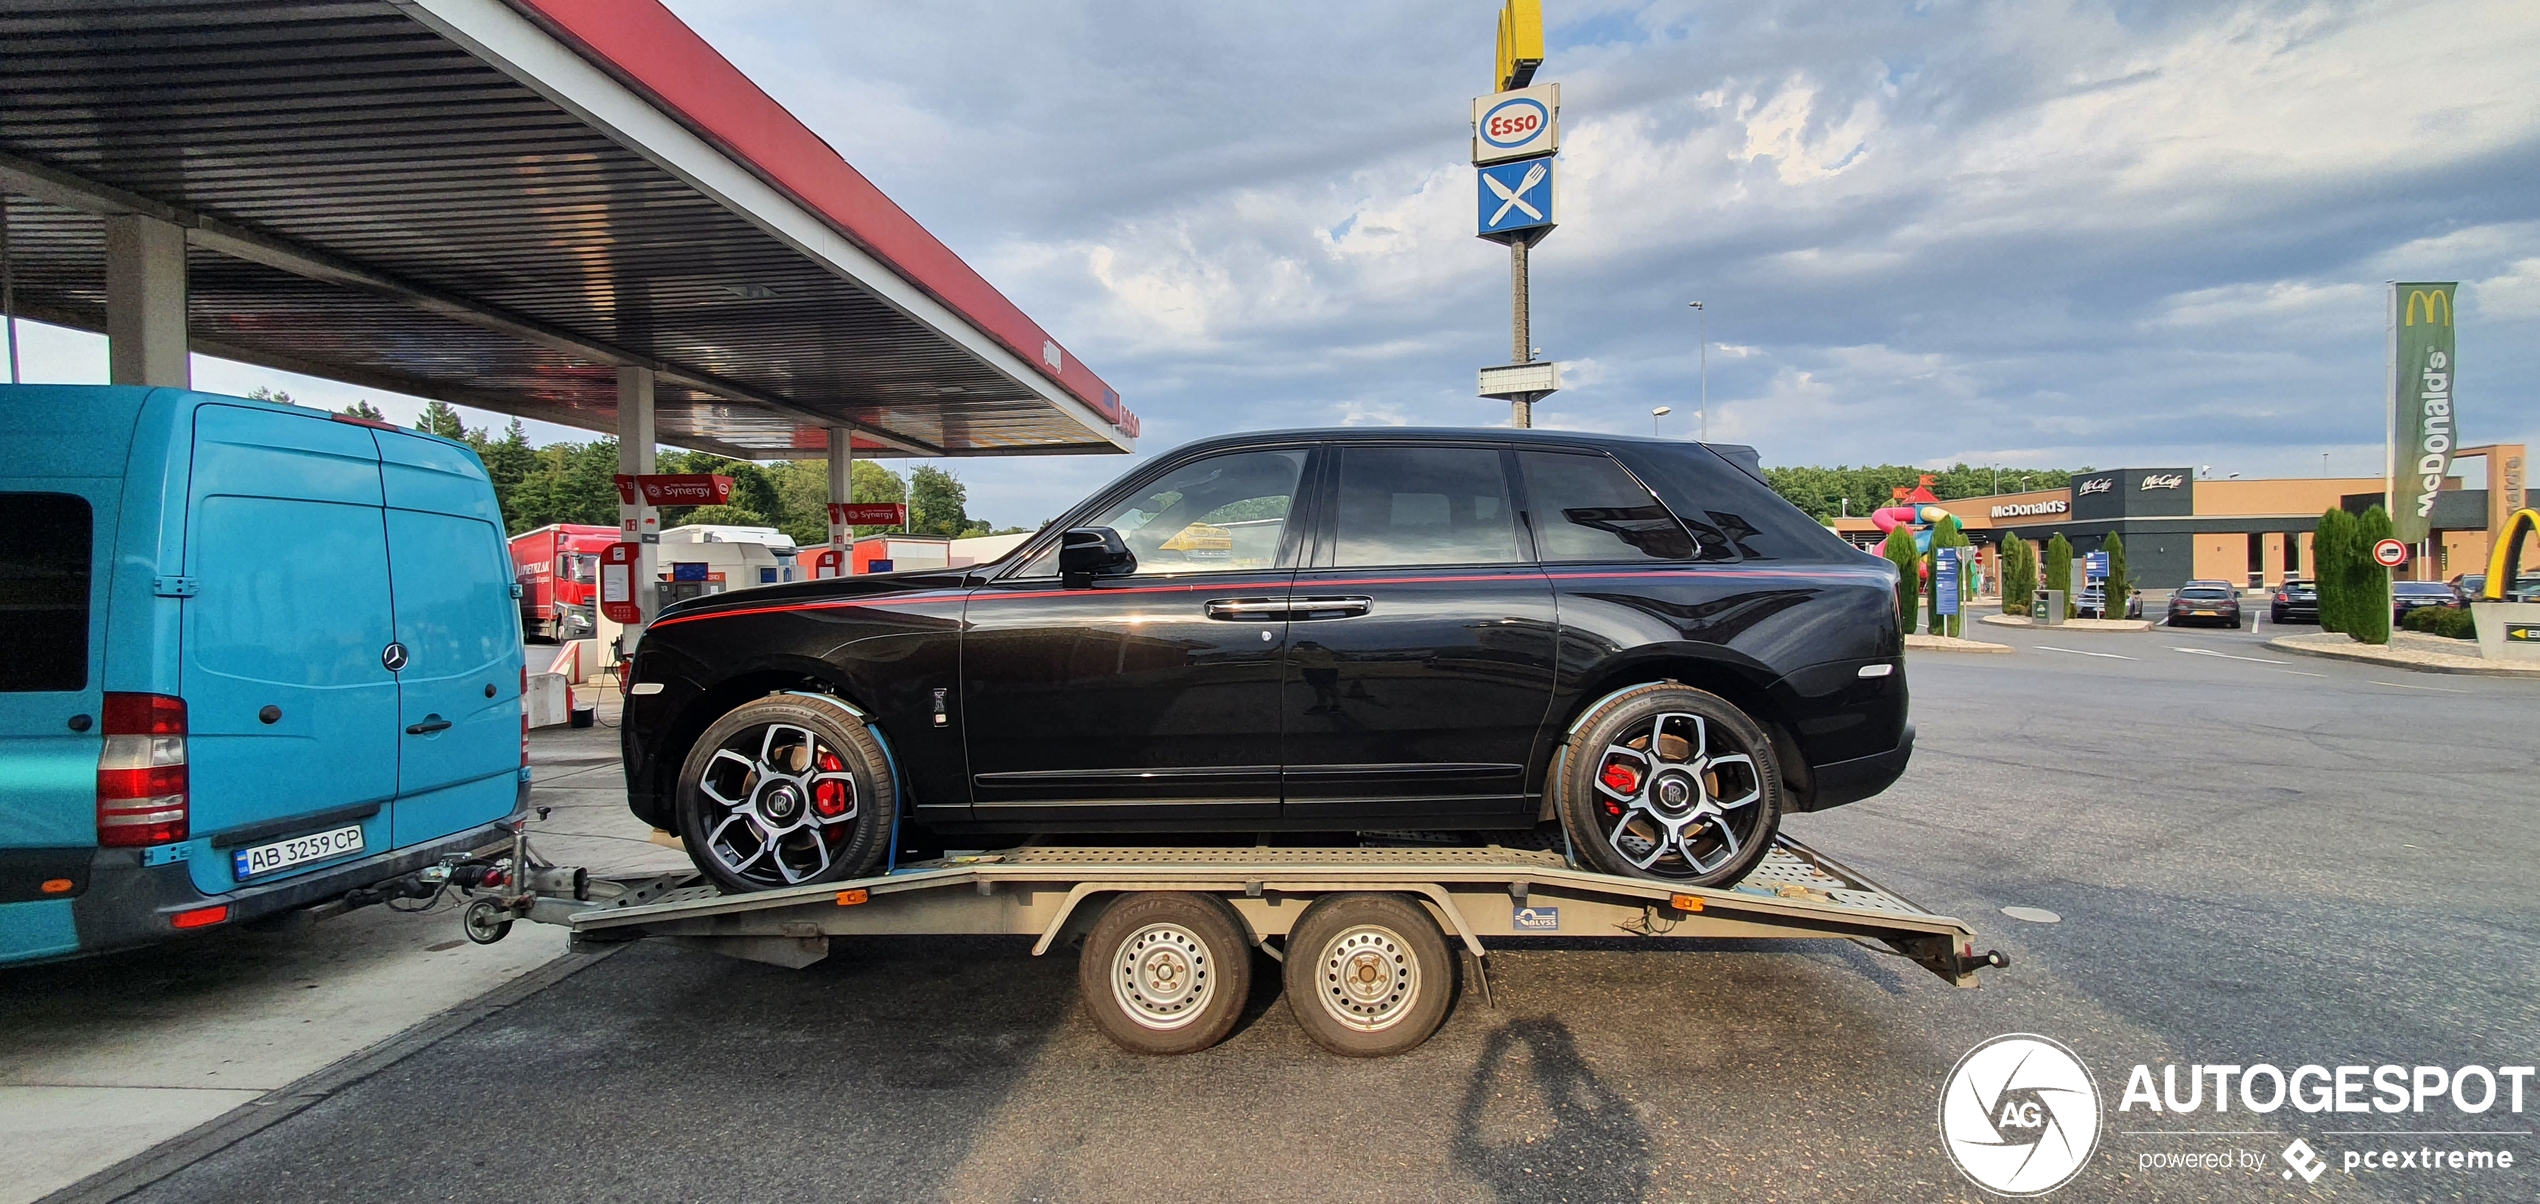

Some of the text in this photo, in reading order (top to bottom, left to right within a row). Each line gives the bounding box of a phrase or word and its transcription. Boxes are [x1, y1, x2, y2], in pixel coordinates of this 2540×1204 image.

[1491, 114, 1537, 136] Esso
[663, 486, 710, 498] Synergy
[861, 511, 894, 520] Synergy
[1991, 500, 2067, 518] McDonald's
[252, 829, 359, 871] AB 3259 CP
